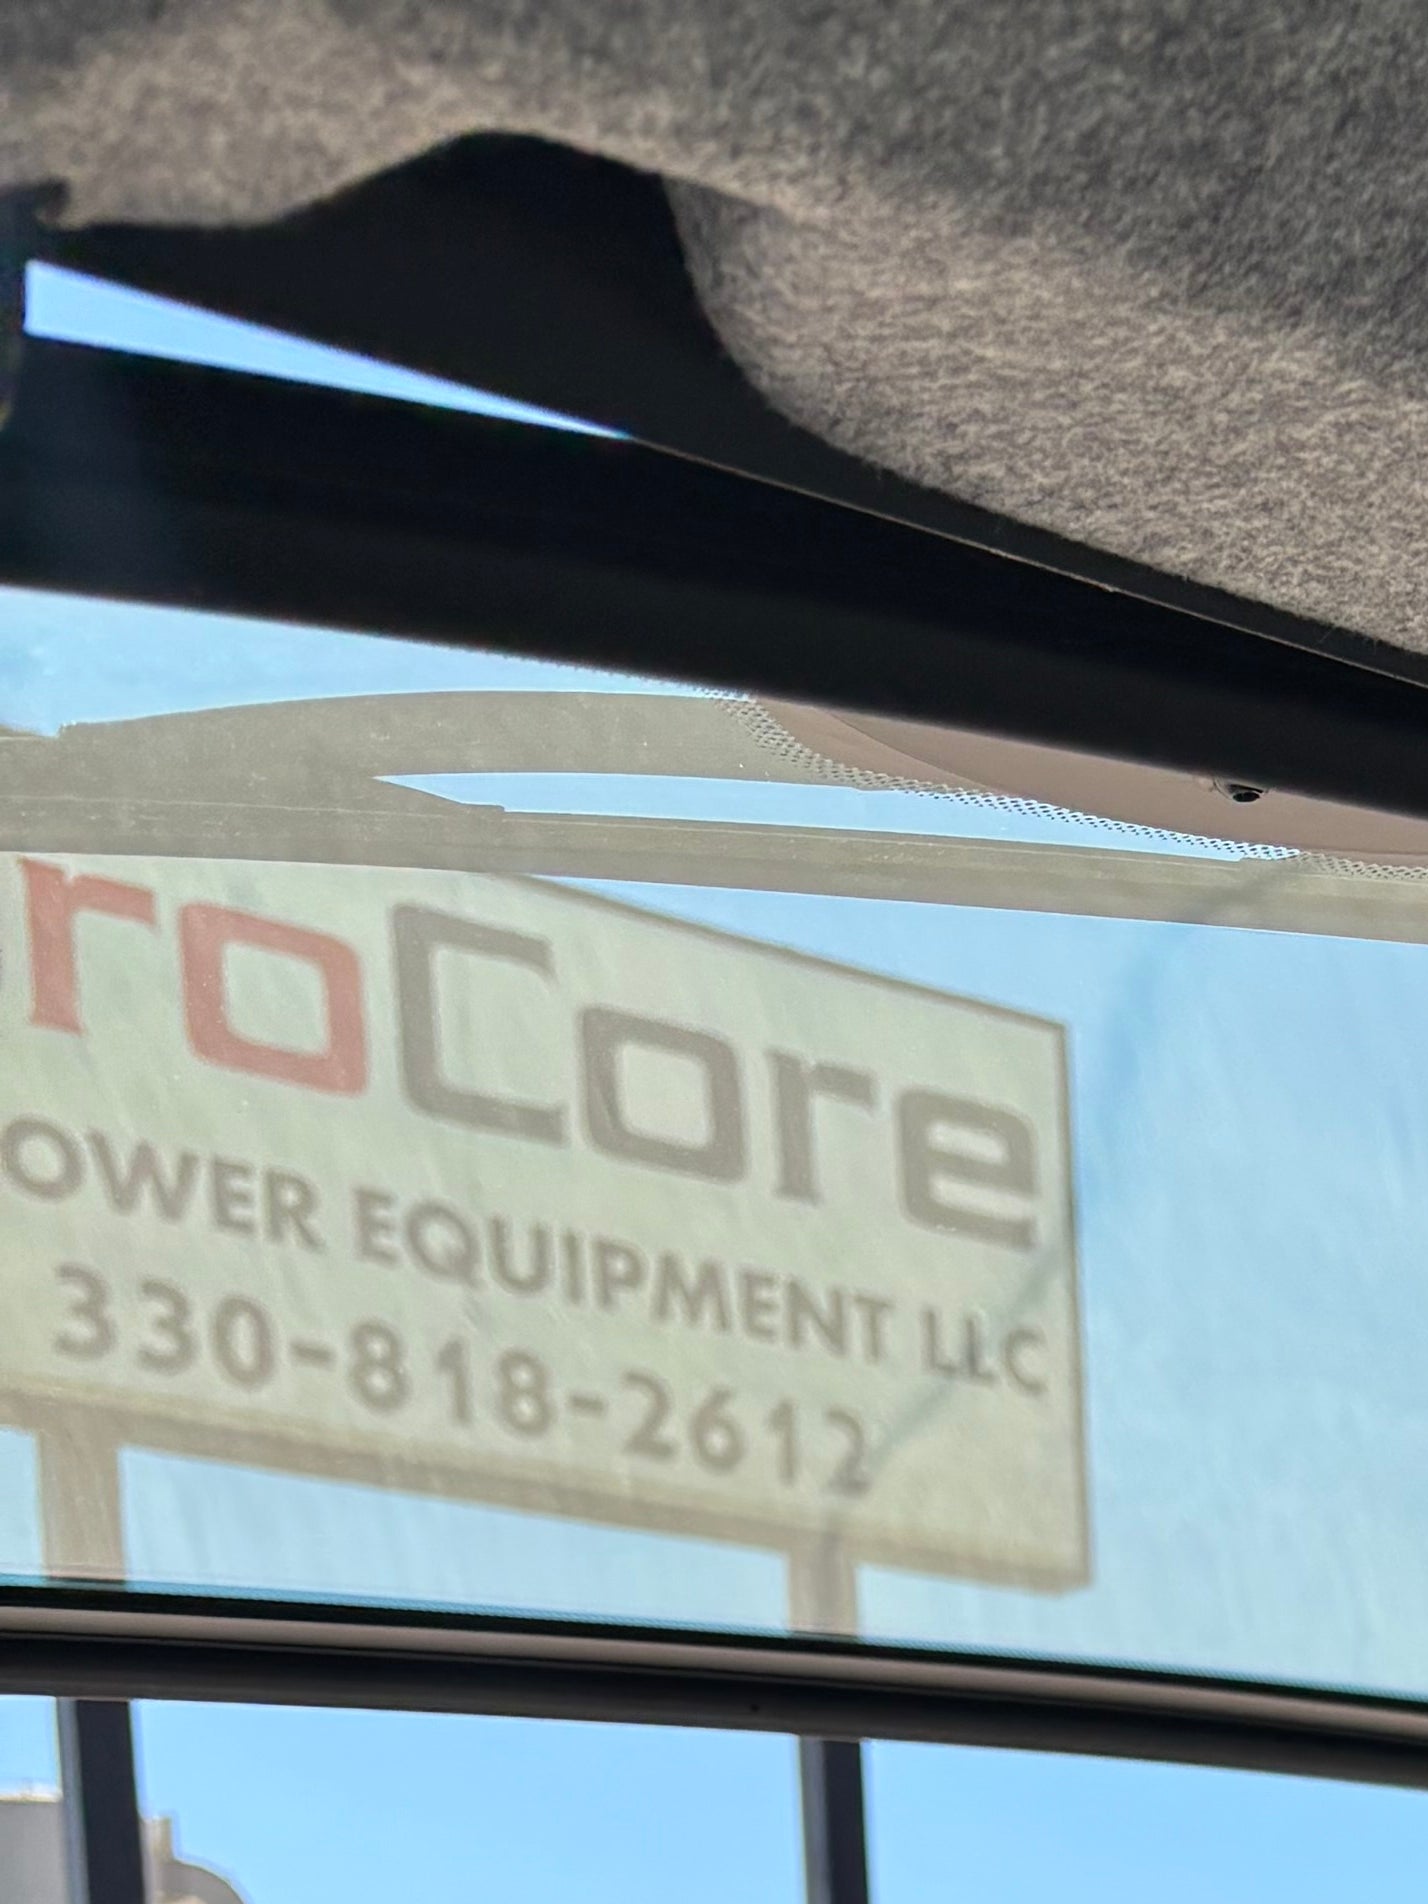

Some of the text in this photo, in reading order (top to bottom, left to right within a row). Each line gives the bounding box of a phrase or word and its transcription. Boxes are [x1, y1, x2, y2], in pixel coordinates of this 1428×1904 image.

[0, 853, 1040, 1251] roCore
[0, 1115, 1049, 1400] OWER EQUIPMENT LLC
[49, 1264, 878, 1495] 330-818-2612
